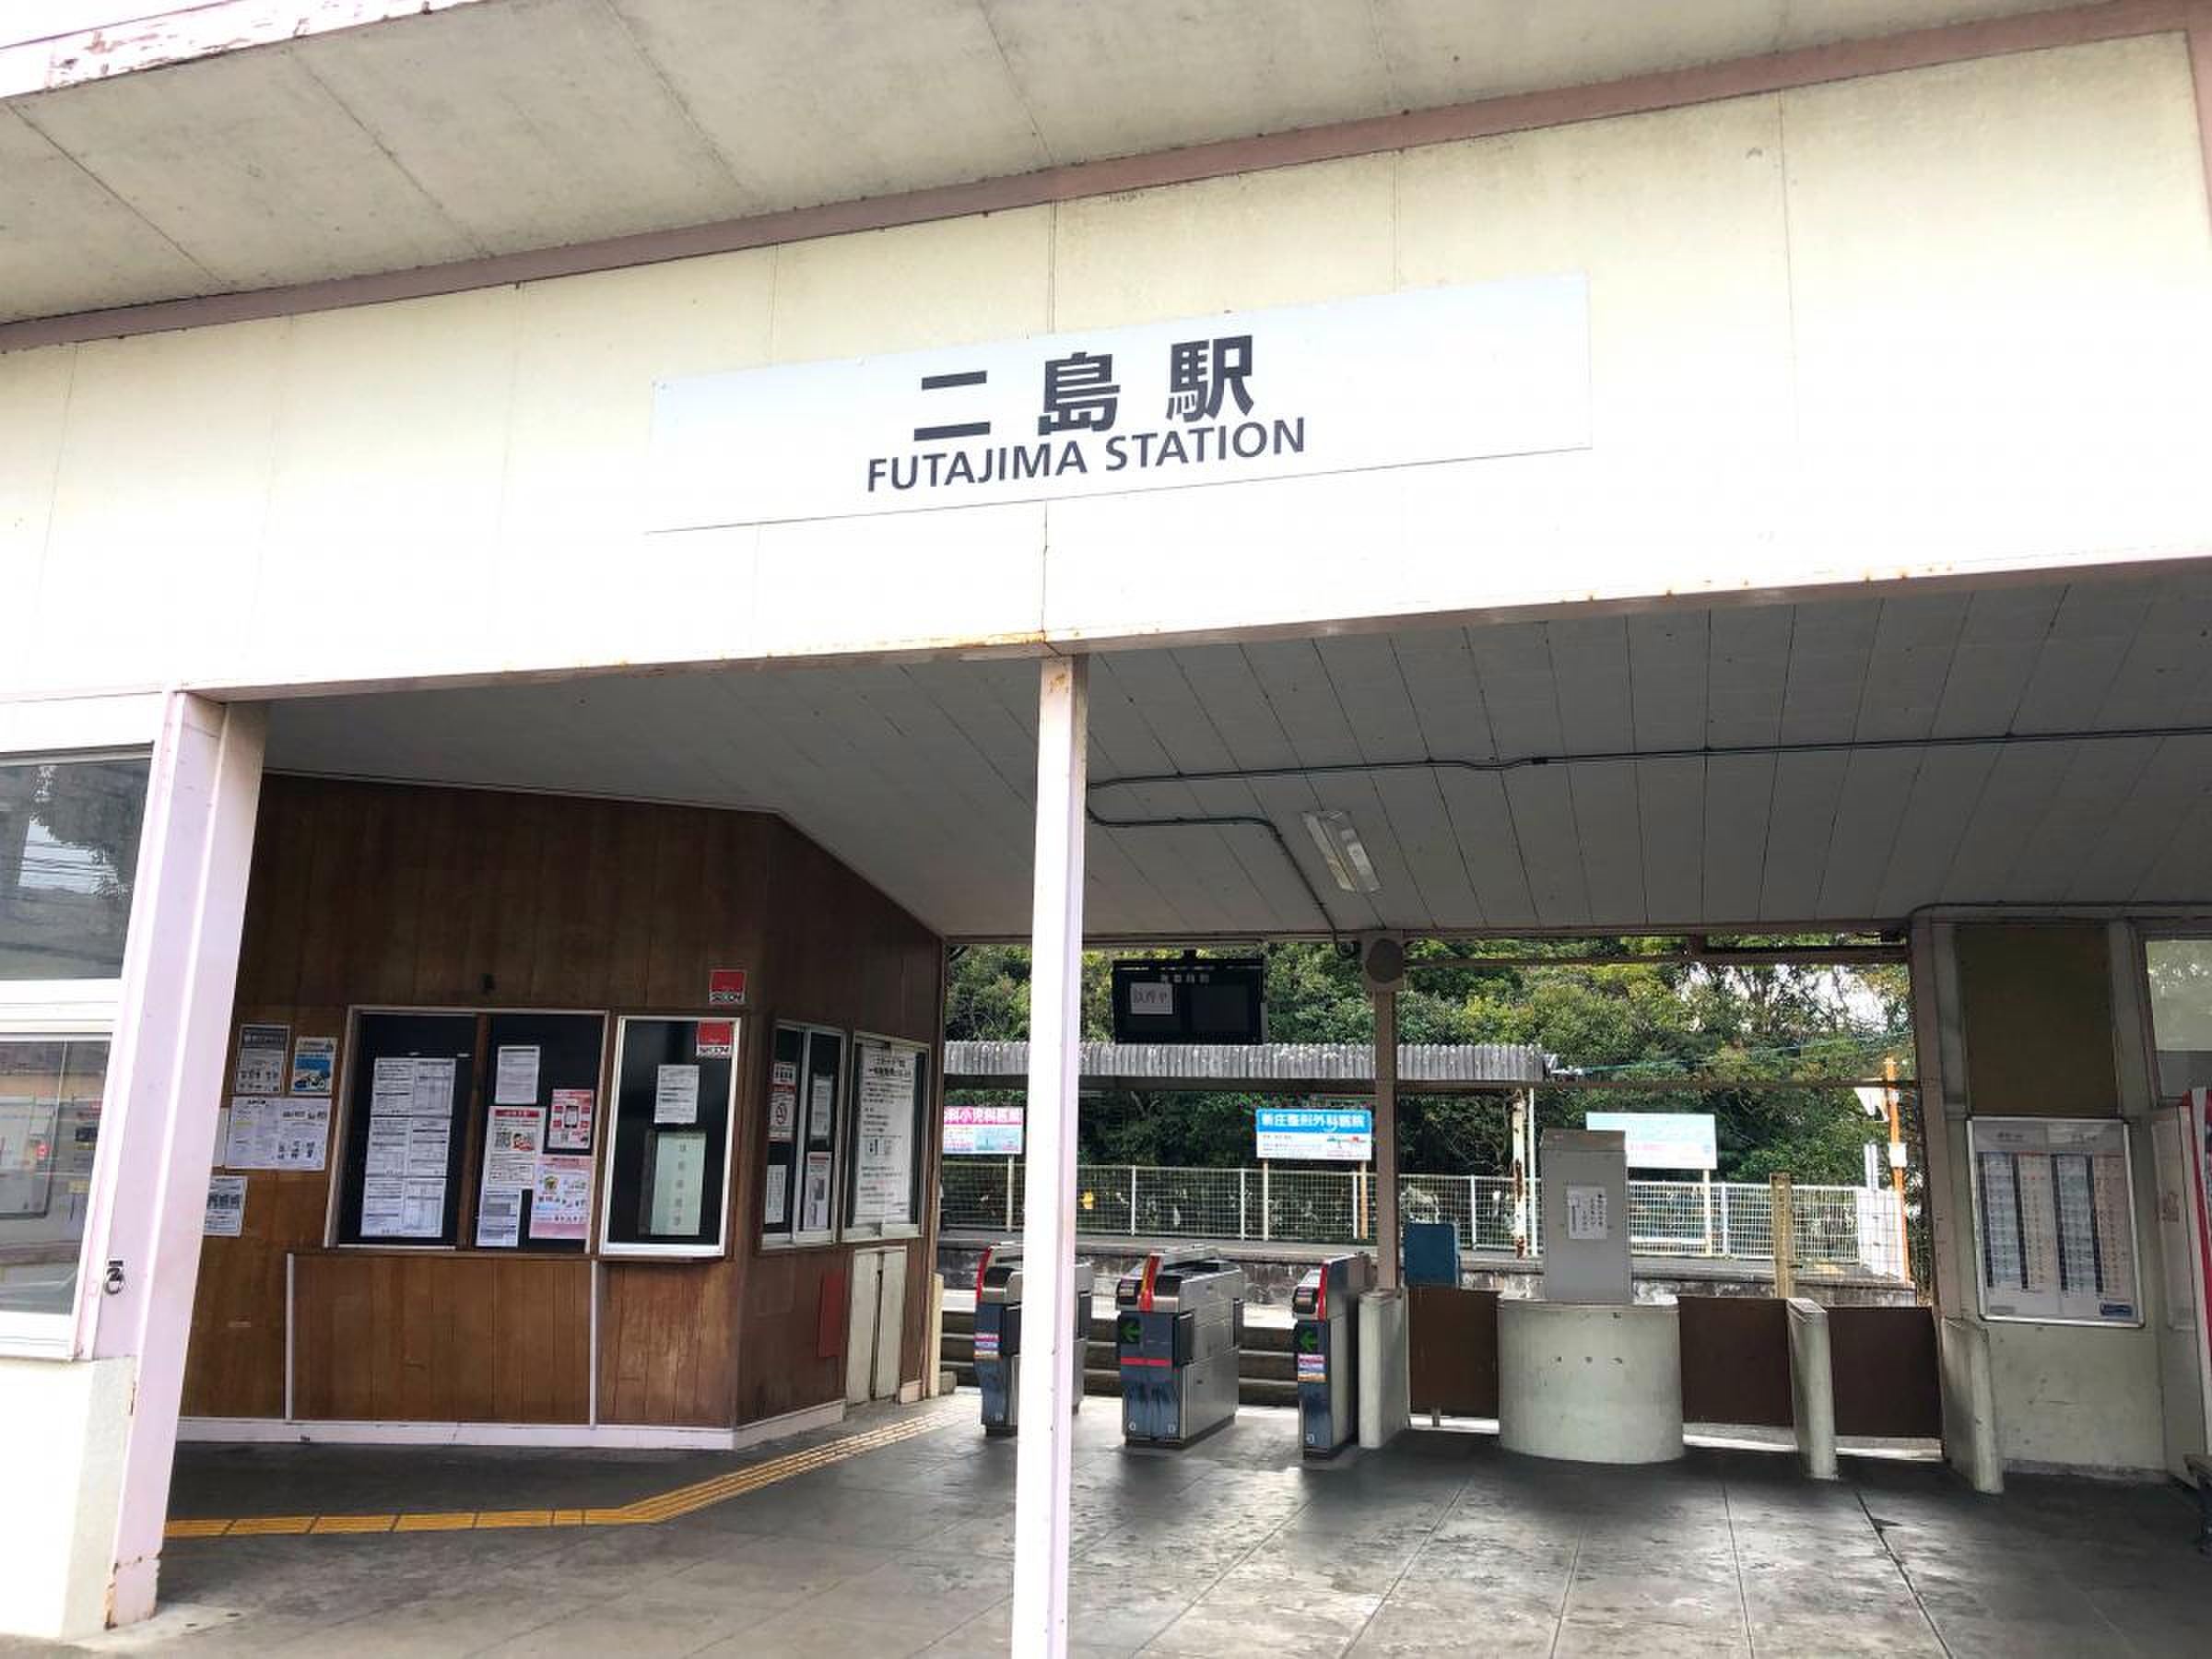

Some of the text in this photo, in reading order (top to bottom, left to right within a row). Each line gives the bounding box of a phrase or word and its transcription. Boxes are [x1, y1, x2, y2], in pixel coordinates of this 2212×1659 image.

[913, 335, 1254, 441] 二島駅
[868, 417, 1304, 492] FUTAJIMA STATION
